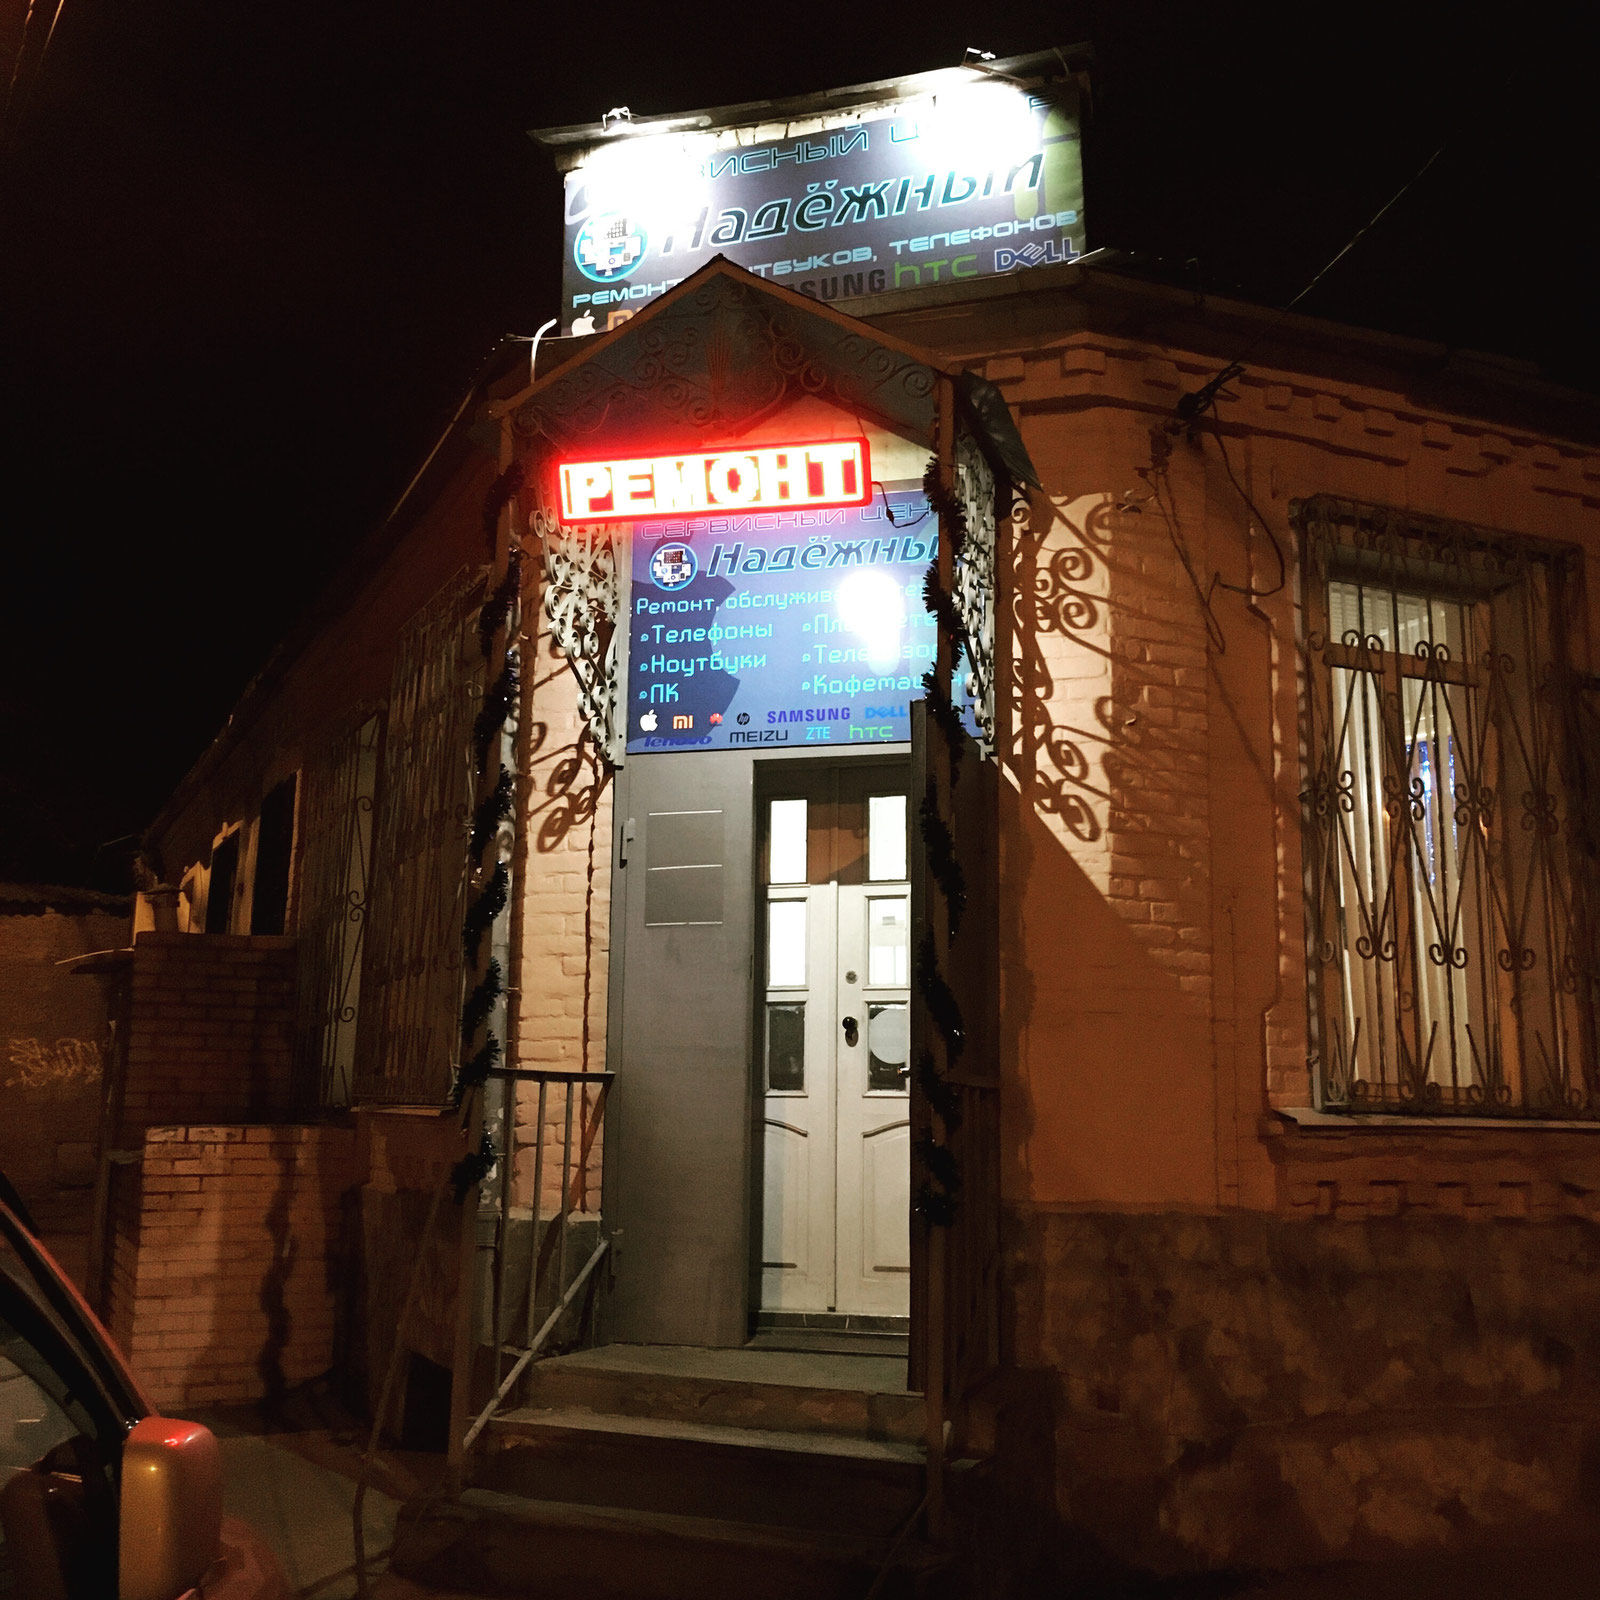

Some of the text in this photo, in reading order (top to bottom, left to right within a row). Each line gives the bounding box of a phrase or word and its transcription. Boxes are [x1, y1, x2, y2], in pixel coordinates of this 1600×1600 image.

[888, 209, 1078, 255] ТЕЛЕФОНОВ
[994, 238, 1080, 272] DELL
[566, 443, 856, 517] РЕМОНТ
[641, 507, 846, 539] СЕРВИСНЫЙ
[706, 535, 938, 578] Надёжны
[651, 622, 774, 646] Телефоны
[650, 651, 767, 677] Ноутбуки
[649, 683, 680, 704] ПК
[766, 707, 852, 724] SAMSUNG
[729, 730, 789, 743] MEIZU
[805, 727, 830, 740] ZTE
